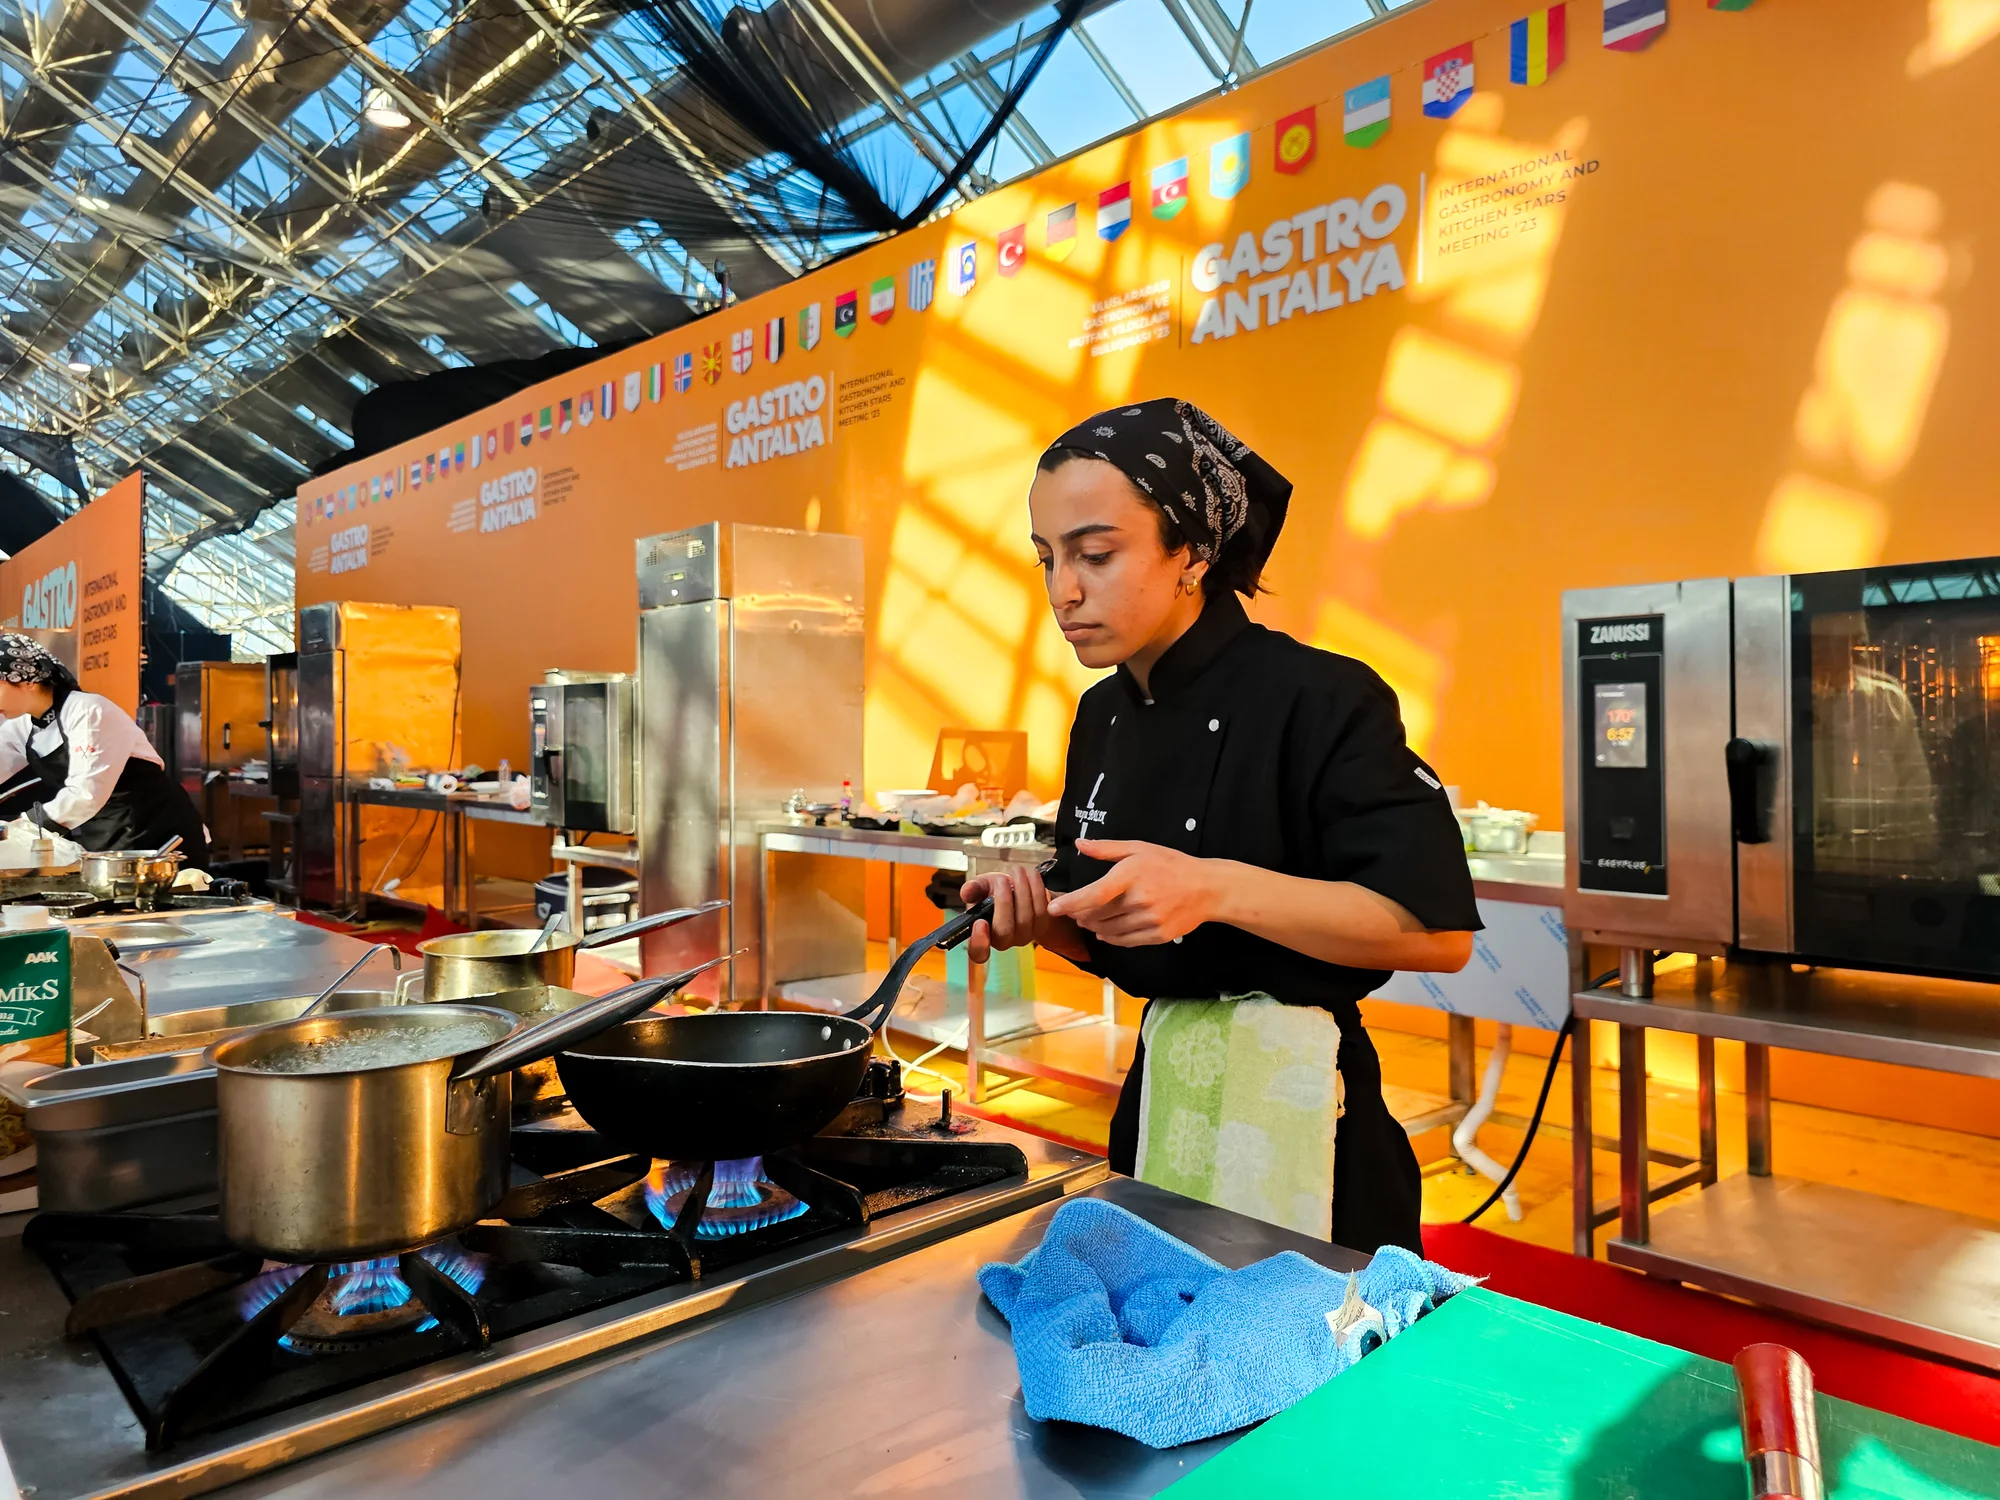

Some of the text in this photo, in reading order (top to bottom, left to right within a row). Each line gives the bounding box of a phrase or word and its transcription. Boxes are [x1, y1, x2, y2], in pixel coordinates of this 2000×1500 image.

[1438, 150, 1574, 201] INTERNATIONAL
[1438, 159, 1600, 220] GASTRONOMY AND
[1438, 190, 1566, 239] KITCHEN STARS
[1191, 183, 1407, 292] GASTRO
[1438, 226, 1509, 257] MEETING
[1190, 242, 1406, 344] ANTALYA
[839, 368, 894, 391] INTERNATIONAL
[839, 377, 906, 404] GASTRONOMY AND
[726, 374, 827, 436] GASTRO
[838, 393, 892, 417] KITCHEN STARS
[838, 411, 869, 428] MEETING
[726, 415, 825, 470] ANTALYA
[481, 466, 537, 508] GASTRO
[480, 496, 537, 534] ANTALYA
[22, 560, 77, 629] GASTRO
[1590, 623, 1650, 644] ZANUSSI
[24, 951, 59, 965] AAK
